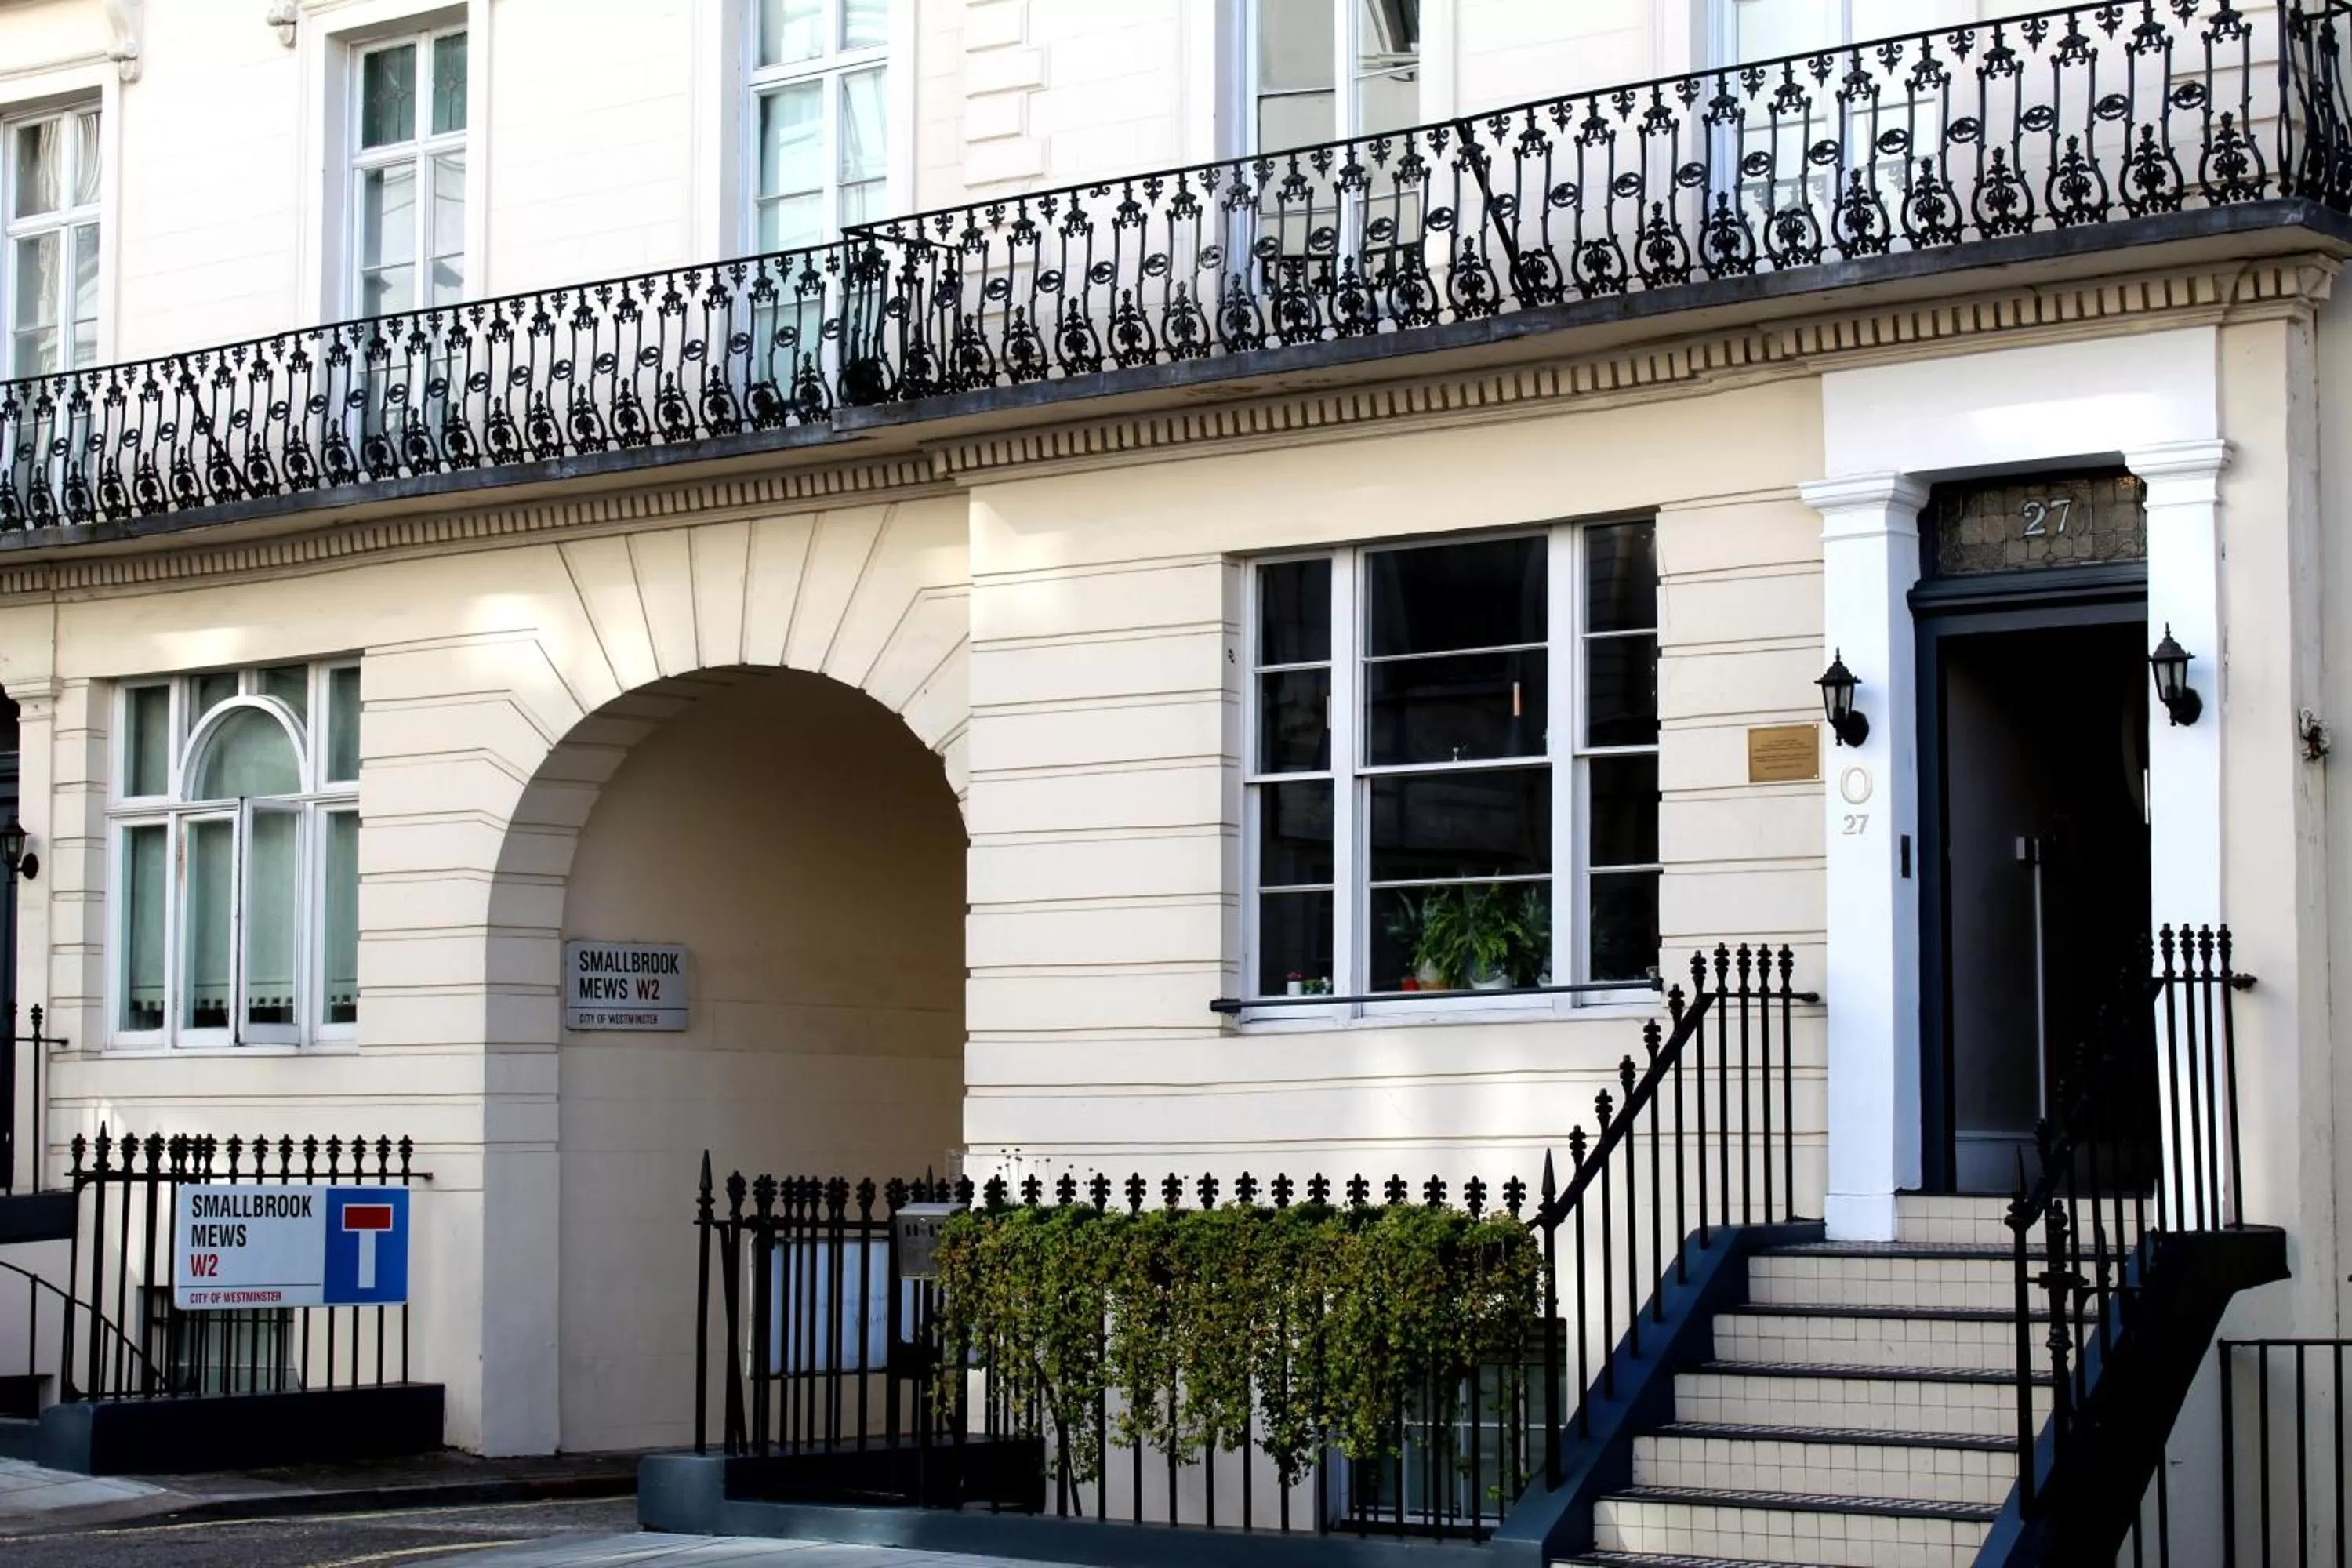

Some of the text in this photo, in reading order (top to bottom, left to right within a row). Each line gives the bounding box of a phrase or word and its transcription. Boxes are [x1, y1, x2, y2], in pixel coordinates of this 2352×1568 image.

[2022, 498, 2072, 536] 27
[1841, 814, 1869, 835] 27
[579, 950, 680, 975] SMALLBROOK
[579, 978, 660, 1000] MEWS W2
[579, 1014, 658, 1025] CITY OF WESTMINSTER
[191, 1194, 312, 1218] SMALLBROOK
[191, 1224, 247, 1247] MEWS
[190, 1254, 218, 1277] W2
[189, 1291, 282, 1304] CITY OF WESTMINSTER
